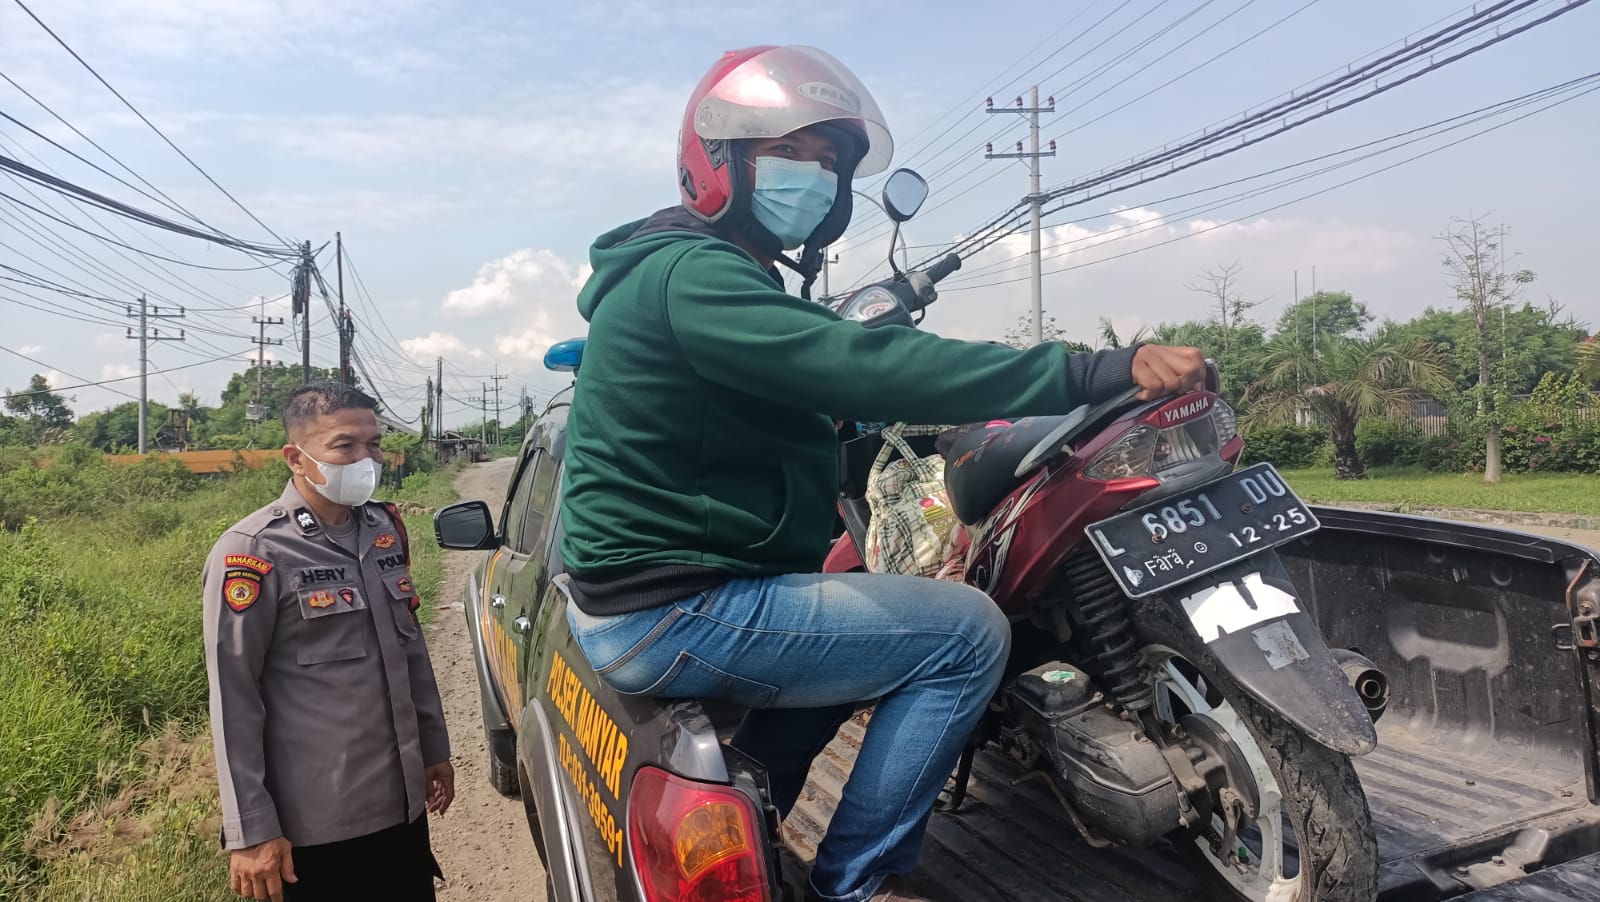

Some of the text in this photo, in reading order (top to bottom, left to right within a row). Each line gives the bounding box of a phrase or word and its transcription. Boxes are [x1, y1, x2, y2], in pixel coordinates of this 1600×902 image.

[1164, 396, 1209, 423] YAMAHA
[1095, 470, 1286, 558] L 6851 DU
[301, 567, 346, 583] HERY
[547, 650, 629, 801] POLSEK MANYAR
